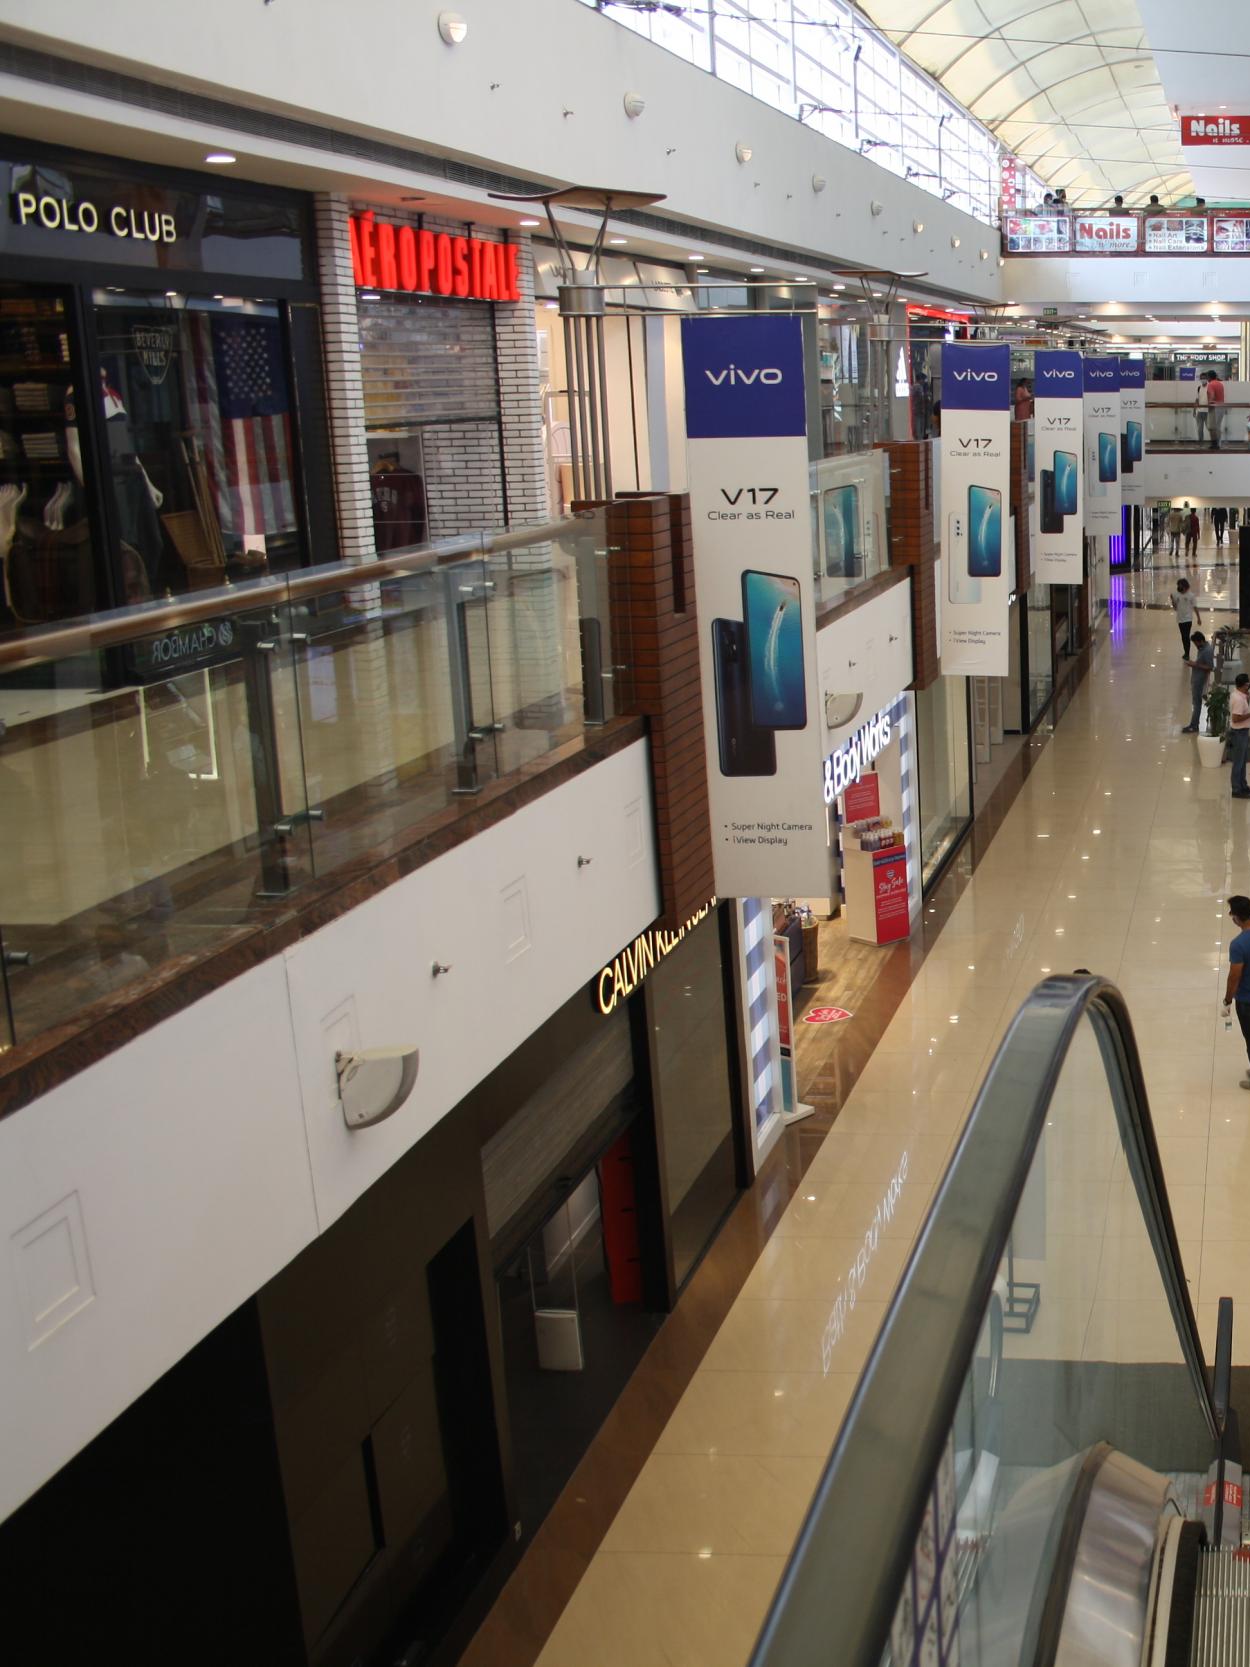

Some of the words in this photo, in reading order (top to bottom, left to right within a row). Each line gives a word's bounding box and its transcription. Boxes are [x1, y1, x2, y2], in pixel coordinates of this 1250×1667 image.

[1191, 118, 1240, 136] Nails
[18, 192, 98, 233] POLO
[111, 206, 177, 243] CLUB
[1079, 222, 1131, 240] Nails
[705, 363, 783, 385] vivo
[953, 368, 998, 381] vivo
[1043, 369, 1075, 378] vivo
[1089, 370, 1114, 378] vivo
[1047, 417, 1071, 425] V17
[959, 438, 993, 448] V17
[721, 488, 779, 506] V17
[707, 511, 742, 521] Clear
[746, 512, 761, 520] as
[765, 510, 795, 520] Real
[824, 760, 834, 803] &
[833, 736, 861, 795] Body
[861, 712, 891, 766] Works
[731, 822, 755, 832] Super
[757, 822, 780, 833] Night
[782, 823, 813, 831] Camera
[758, 836, 788, 846] Display
[599, 931, 655, 1015] CALVIN
